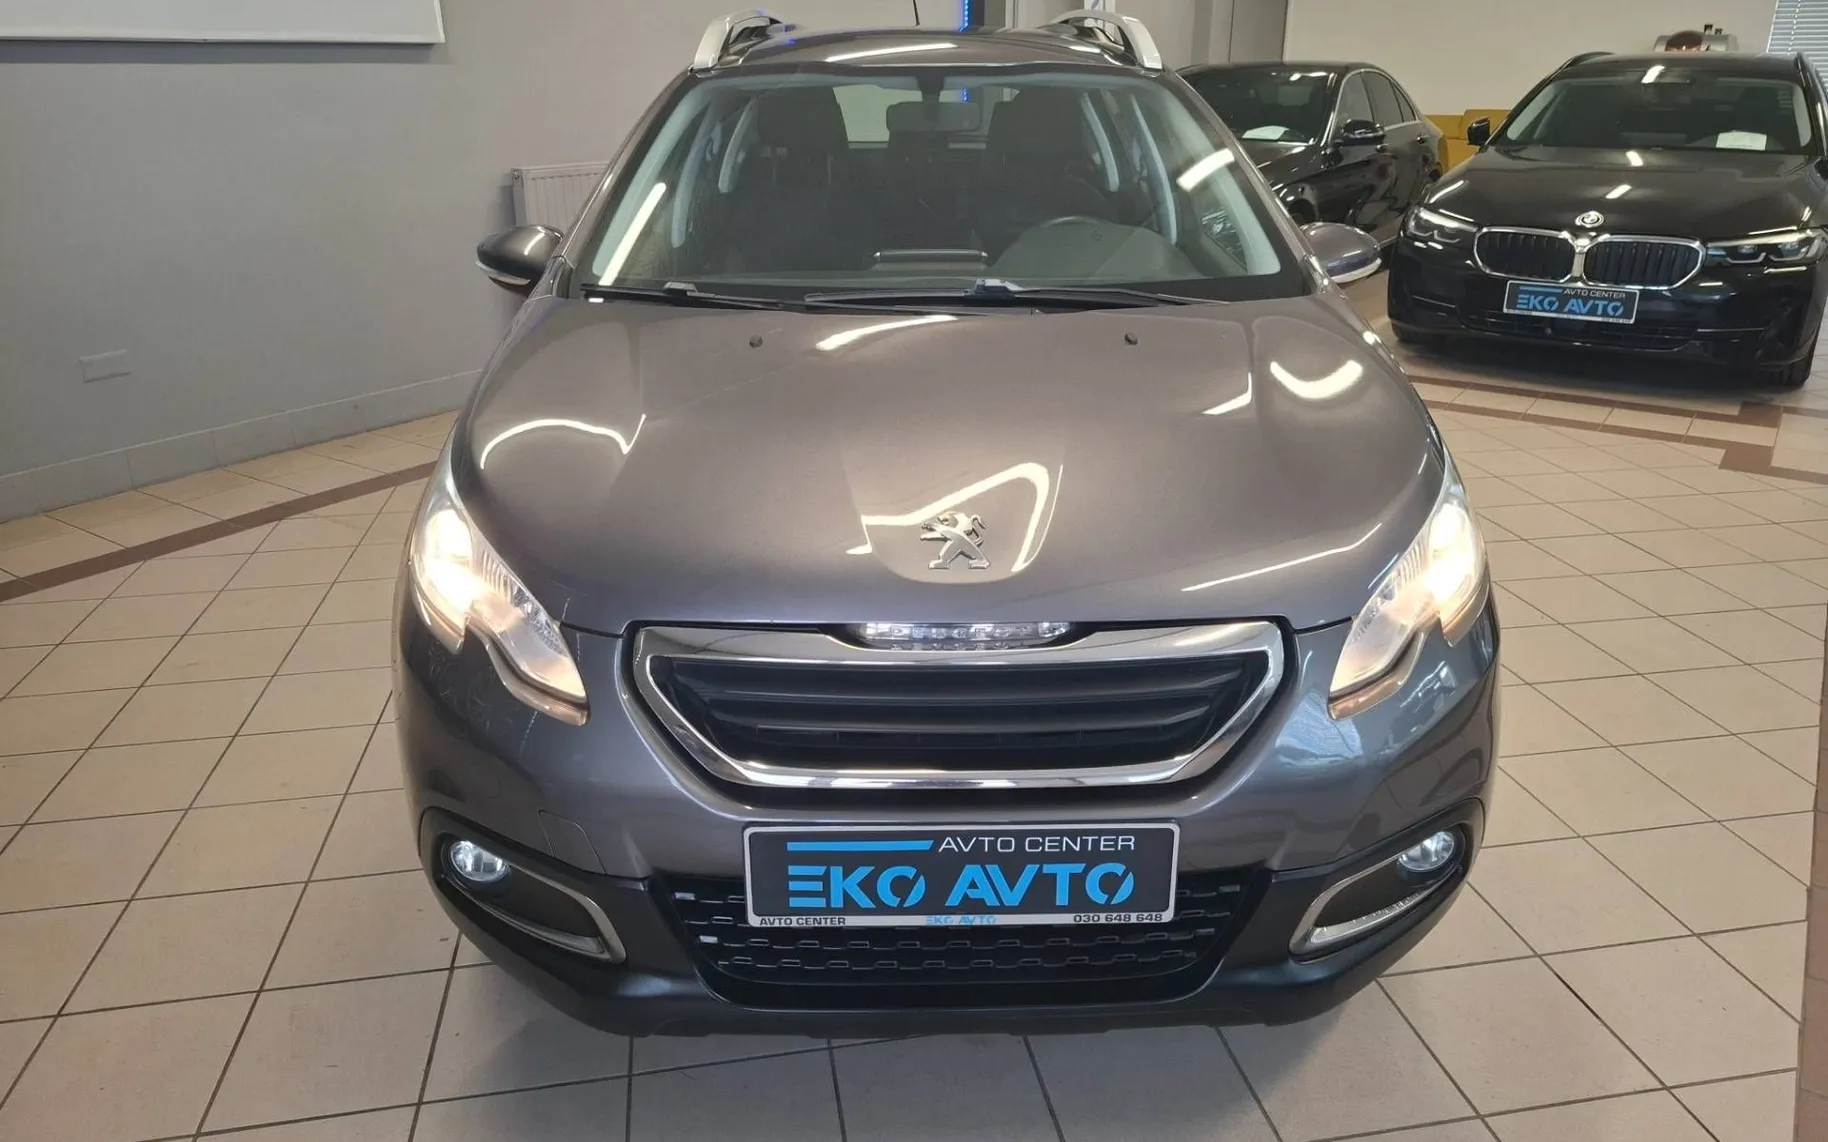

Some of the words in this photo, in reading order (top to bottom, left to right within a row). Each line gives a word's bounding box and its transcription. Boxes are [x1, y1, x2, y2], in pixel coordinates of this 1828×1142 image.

[1563, 288, 1589, 297] AVTO
[1590, 290, 1625, 299] CENTER
[1516, 294, 1559, 311] EKO
[1563, 298, 1624, 317] AVTO
[938, 836, 1015, 852] AVTO
[1024, 835, 1135, 852] CENTER
[787, 865, 926, 908] EKO
[945, 863, 1135, 907] AVTO
[759, 917, 793, 926] AVTO
[796, 917, 846, 926] CENTER
[925, 916, 954, 925] EKO
[958, 915, 997, 925] AVTO
[1073, 914, 1100, 924] 030
[1105, 914, 1132, 923] 648
[1136, 913, 1163, 923] 648
